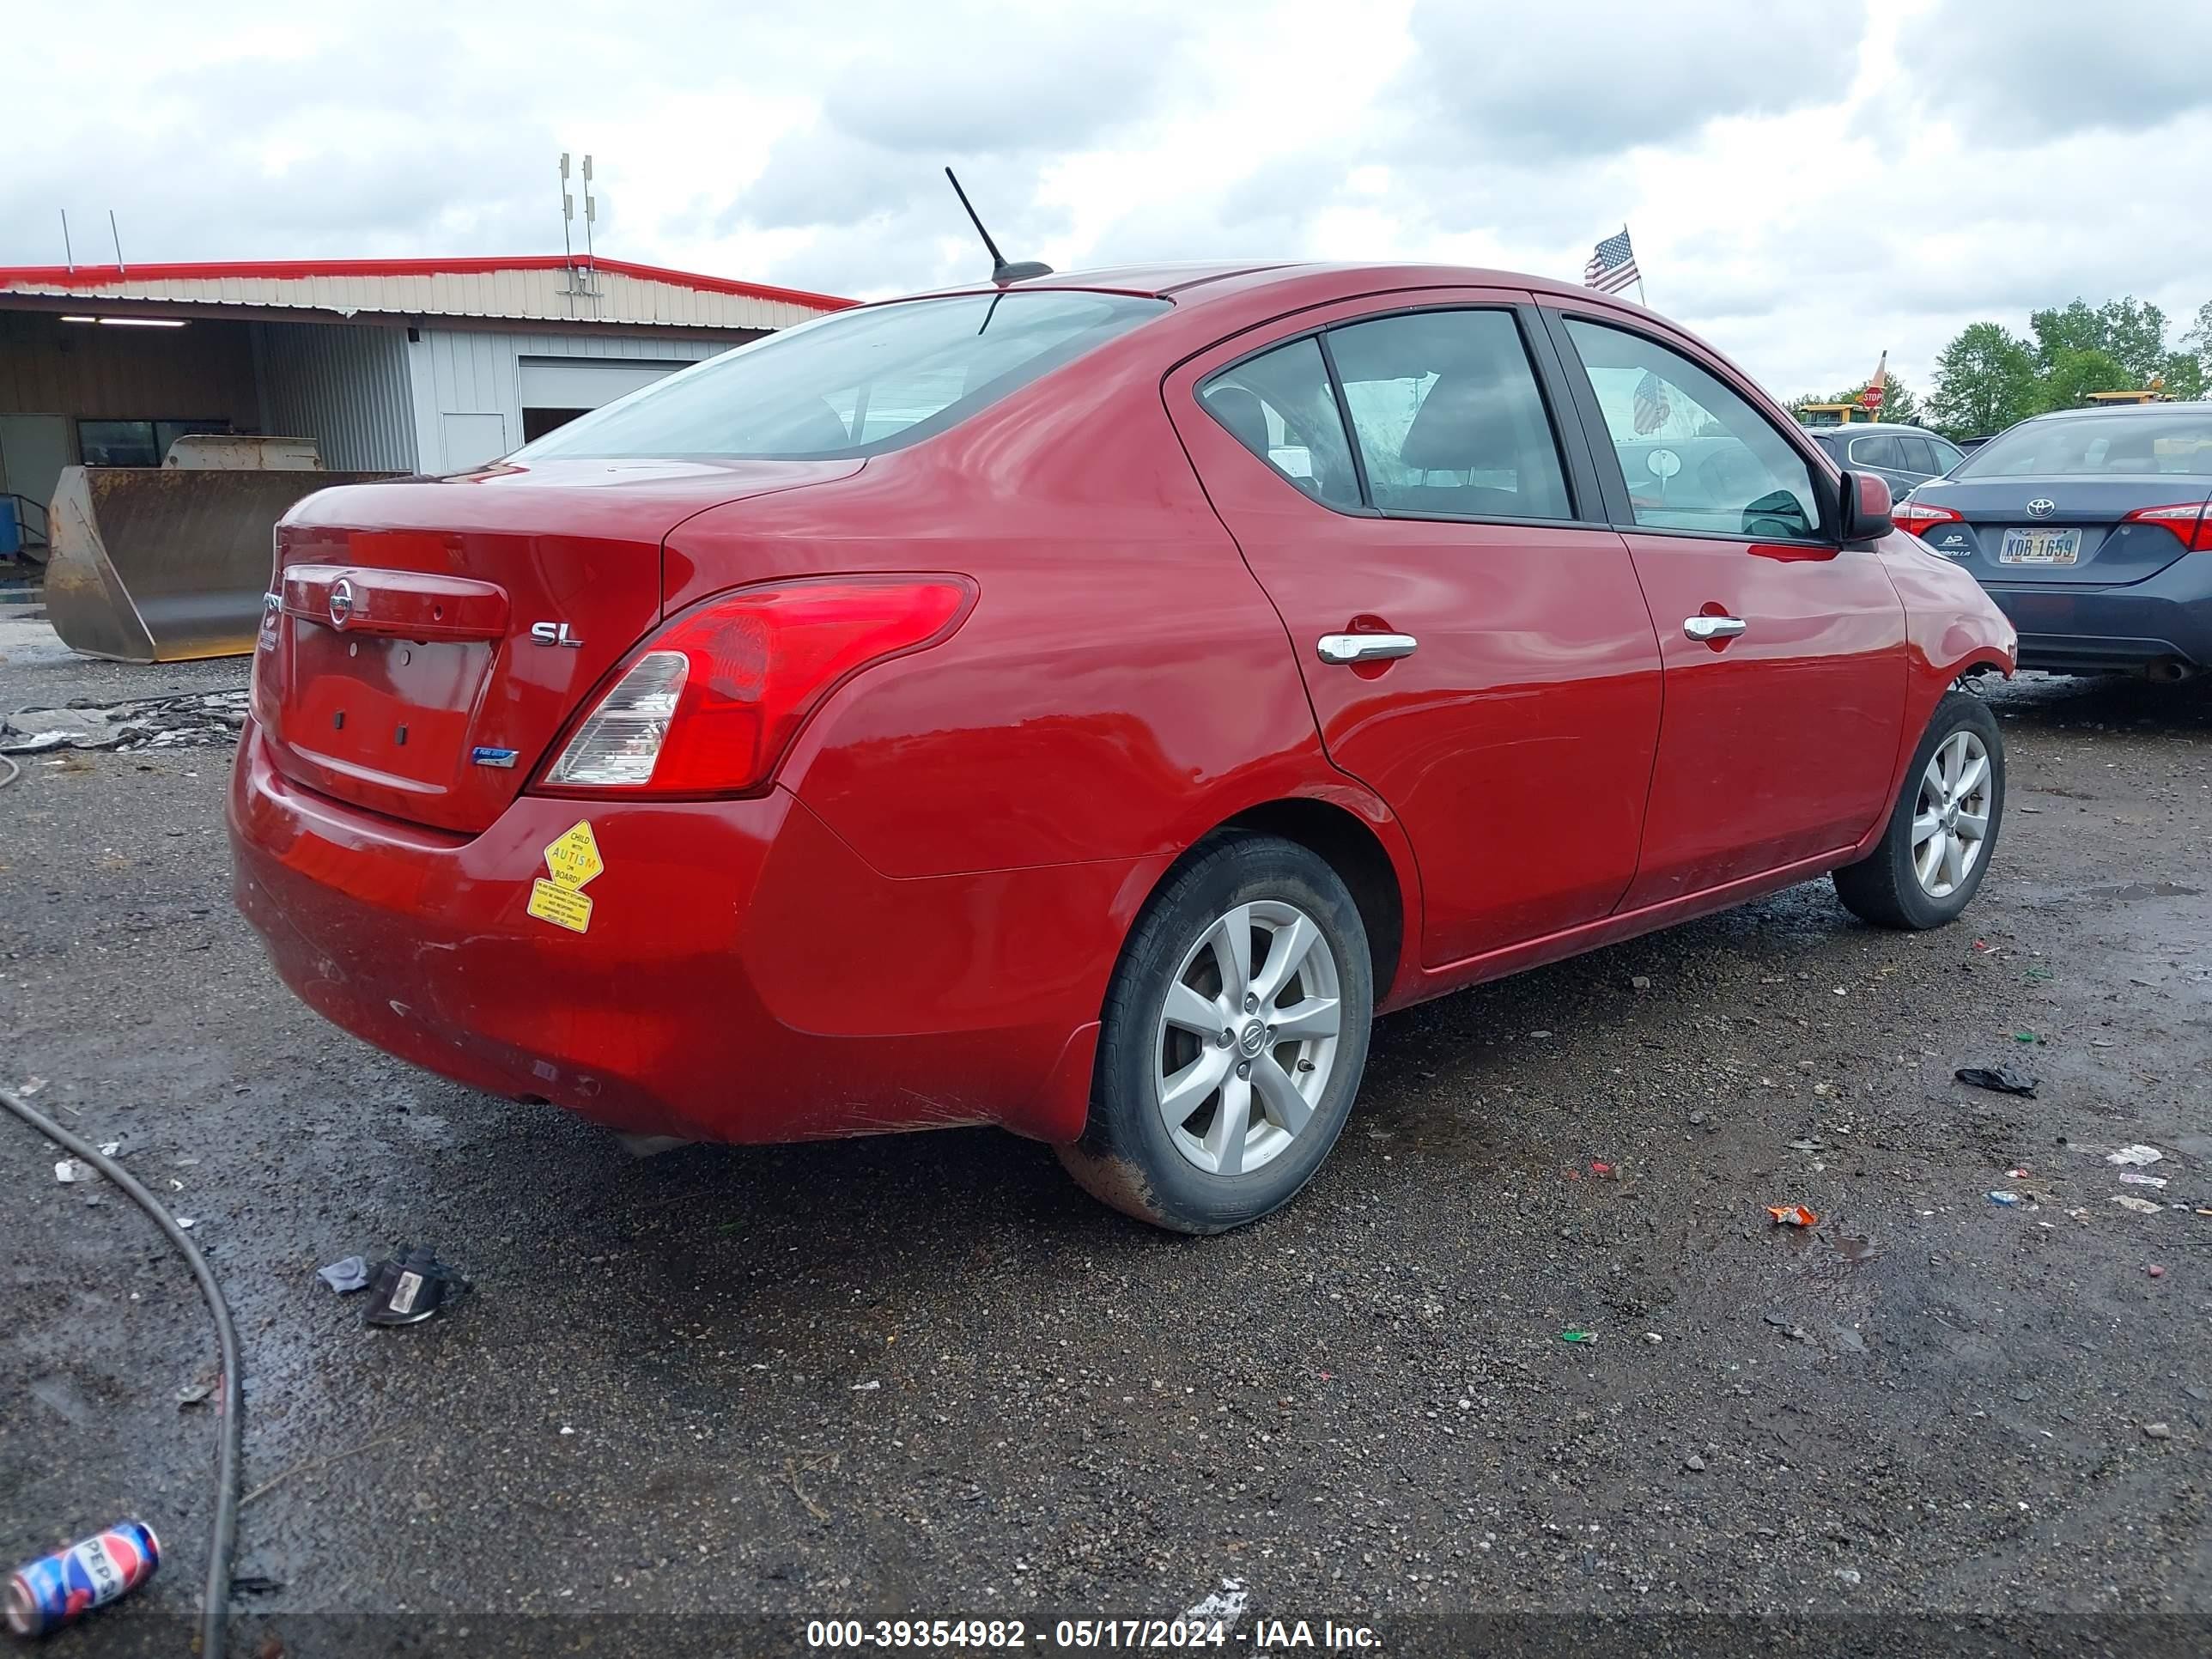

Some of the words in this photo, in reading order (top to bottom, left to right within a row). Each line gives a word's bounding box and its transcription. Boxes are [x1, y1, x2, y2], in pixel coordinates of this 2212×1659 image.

[1863, 392, 1883, 402] STOP
[2006, 538, 2033, 557] KDB
[2037, 538, 2074, 557] 1659
[530, 621, 585, 647] SL
[570, 832, 590, 845] CHILD
[552, 847, 596, 870] AUTISM
[555, 869, 581, 884] BOARD!
